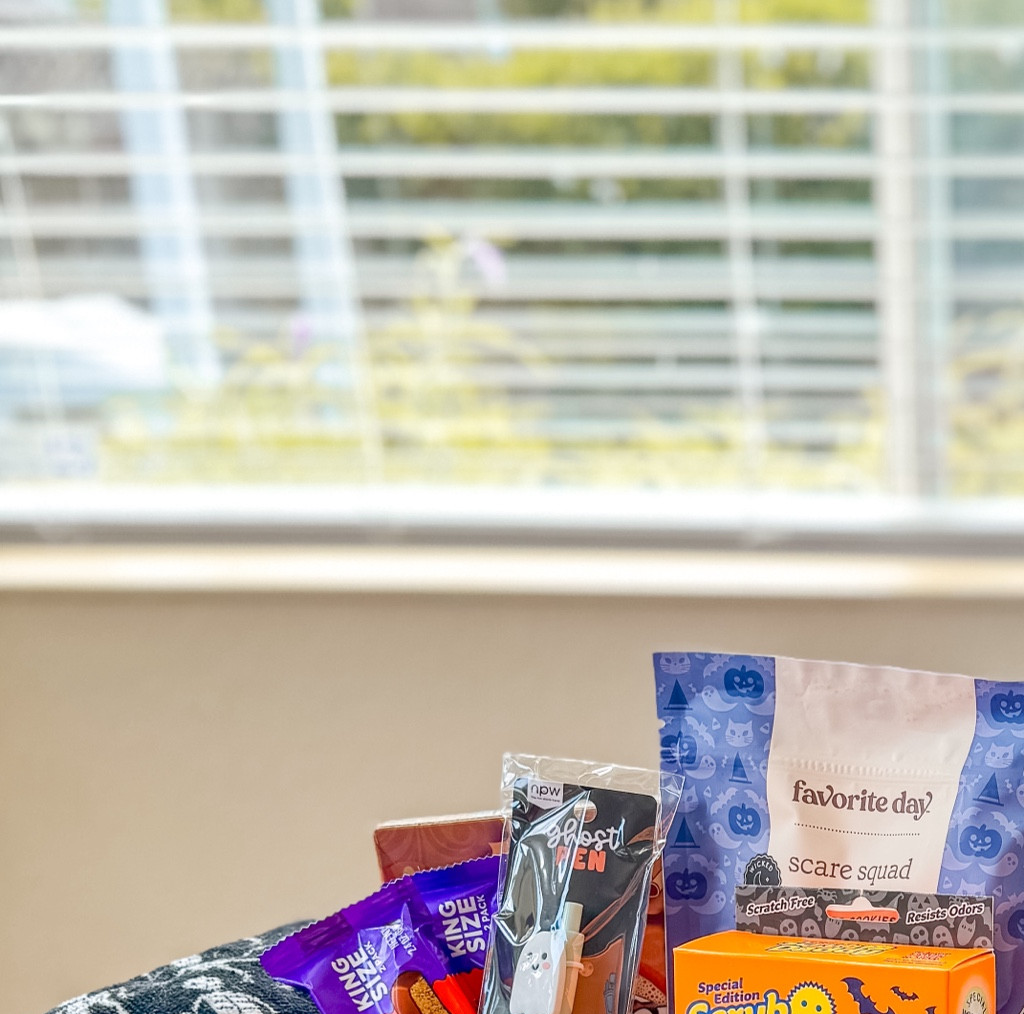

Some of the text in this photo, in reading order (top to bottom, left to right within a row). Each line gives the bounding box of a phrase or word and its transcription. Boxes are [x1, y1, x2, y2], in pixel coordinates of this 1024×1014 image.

[530, 783, 561, 796] npw
[792, 779, 933, 821] favorite day
[547, 818, 620, 851] ghost
[555, 846, 606, 873] PEN
[749, 860, 774, 875] WICKED
[788, 856, 913, 885] scare squad
[476, 894, 491, 922] PACK
[746, 896, 816, 916] Scratch Free
[906, 903, 984, 924] Resists Odors
[439, 901, 467, 958] KING
[456, 896, 486, 953] SIZE
[364, 940, 387, 974] 2 PACK
[331, 957, 375, 1012] KING
[350, 947, 388, 1003] SIZE
[698, 977, 743, 997] Special
[714, 990, 760, 1004] Edition
[966, 991, 988, 1014] SPECIAL
